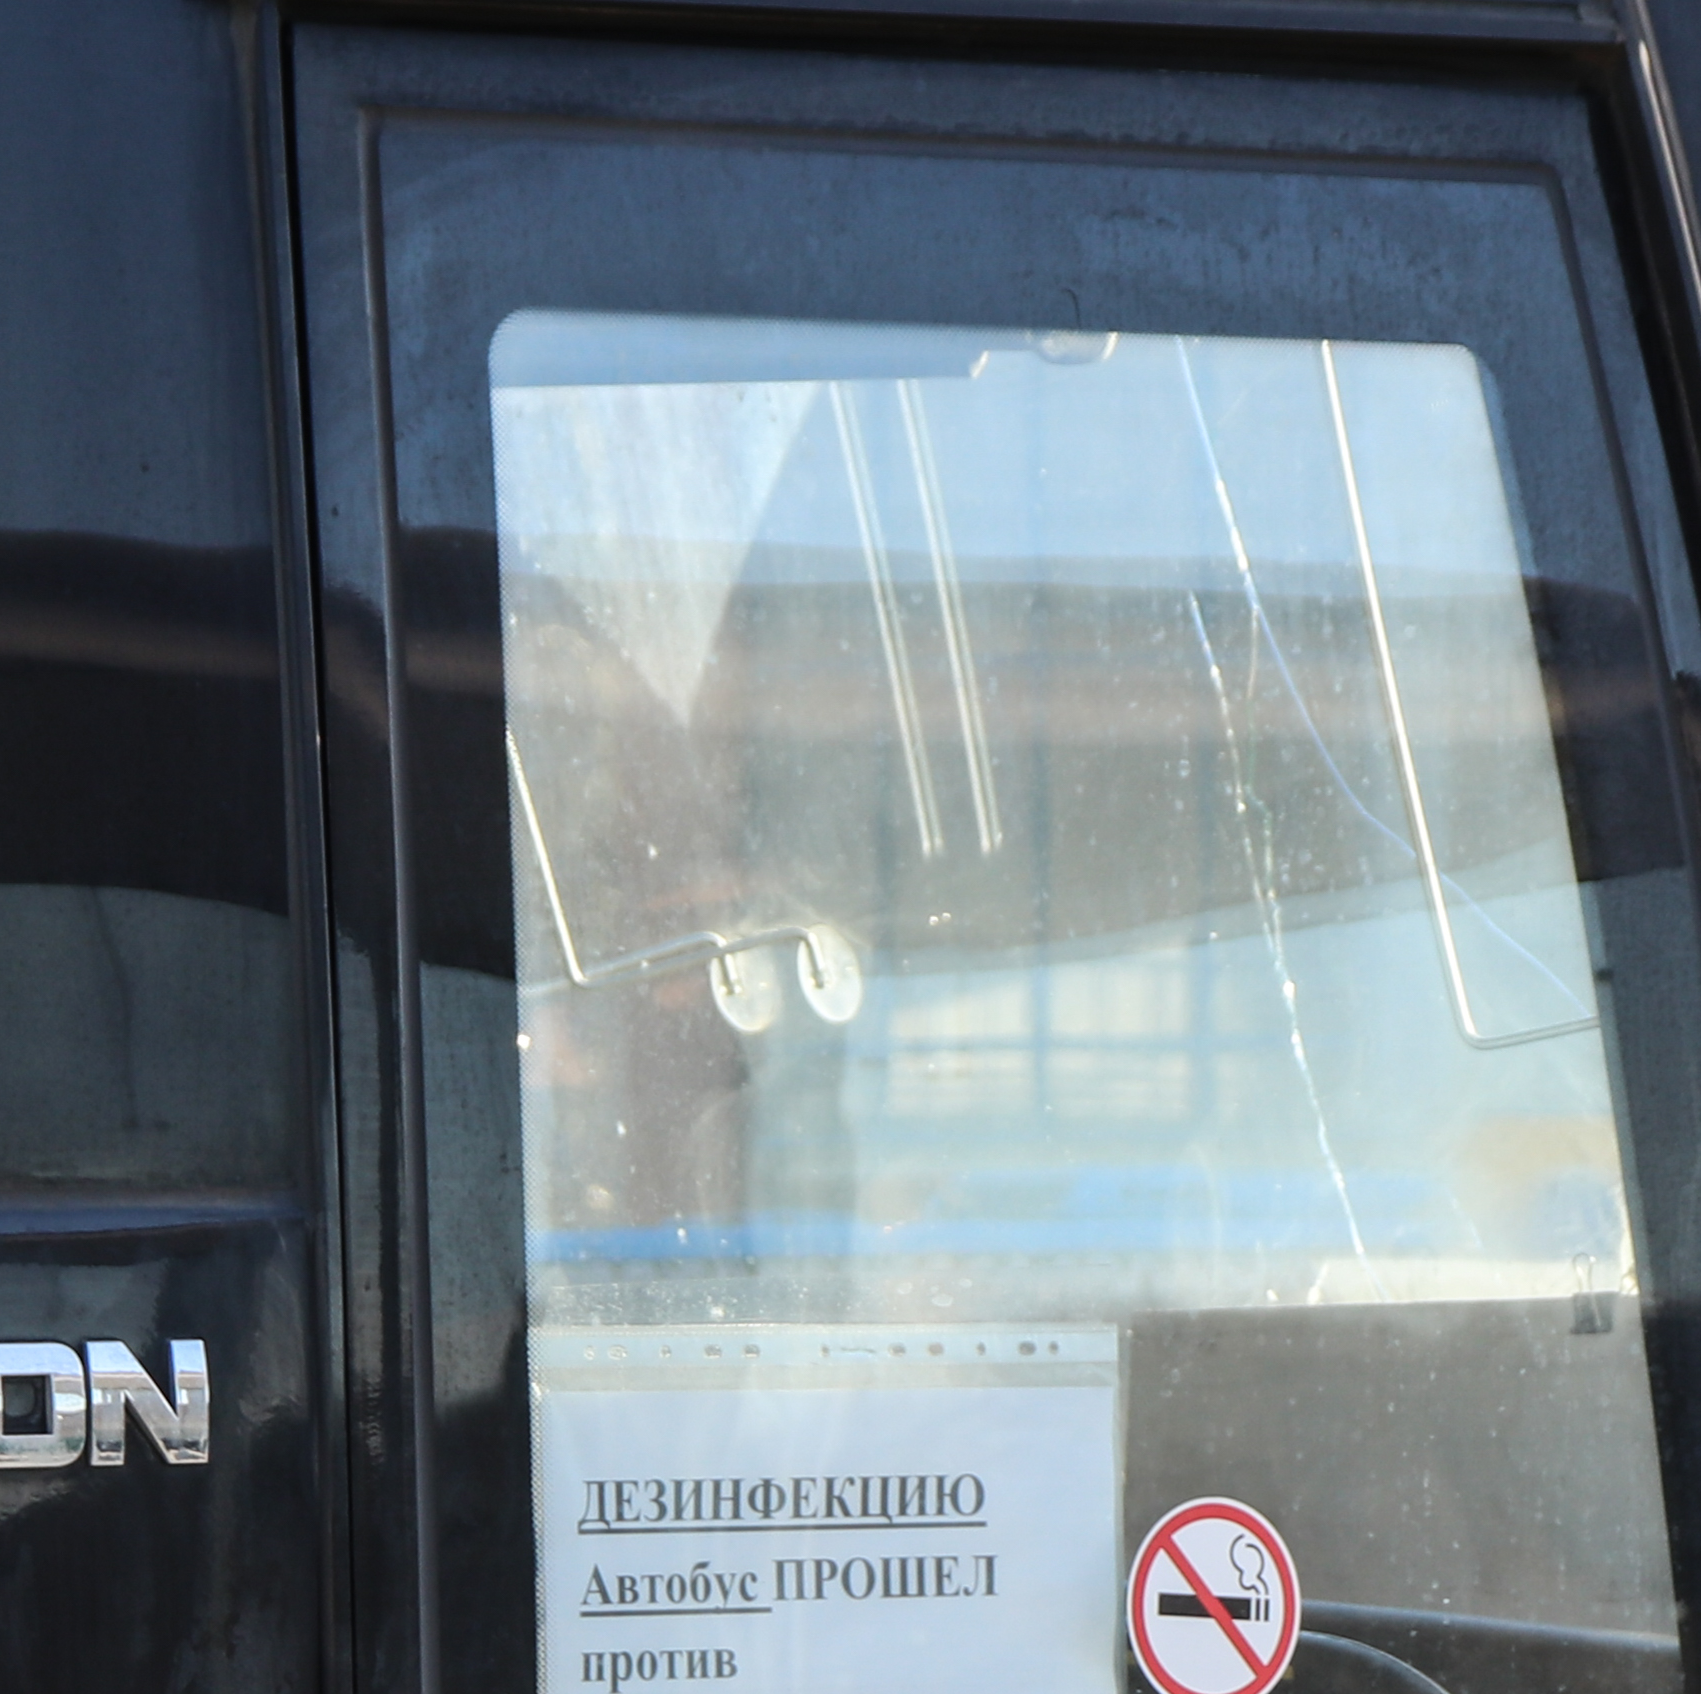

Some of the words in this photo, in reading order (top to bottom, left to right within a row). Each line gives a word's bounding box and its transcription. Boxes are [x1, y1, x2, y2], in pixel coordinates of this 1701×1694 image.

[579, 1473, 986, 1530] ДЕЗИНФЕКЦИЮ
[580, 1561, 759, 1609] Автобус
[772, 1555, 998, 1601] ПРОШЕЛ
[581, 1647, 738, 1693] против
